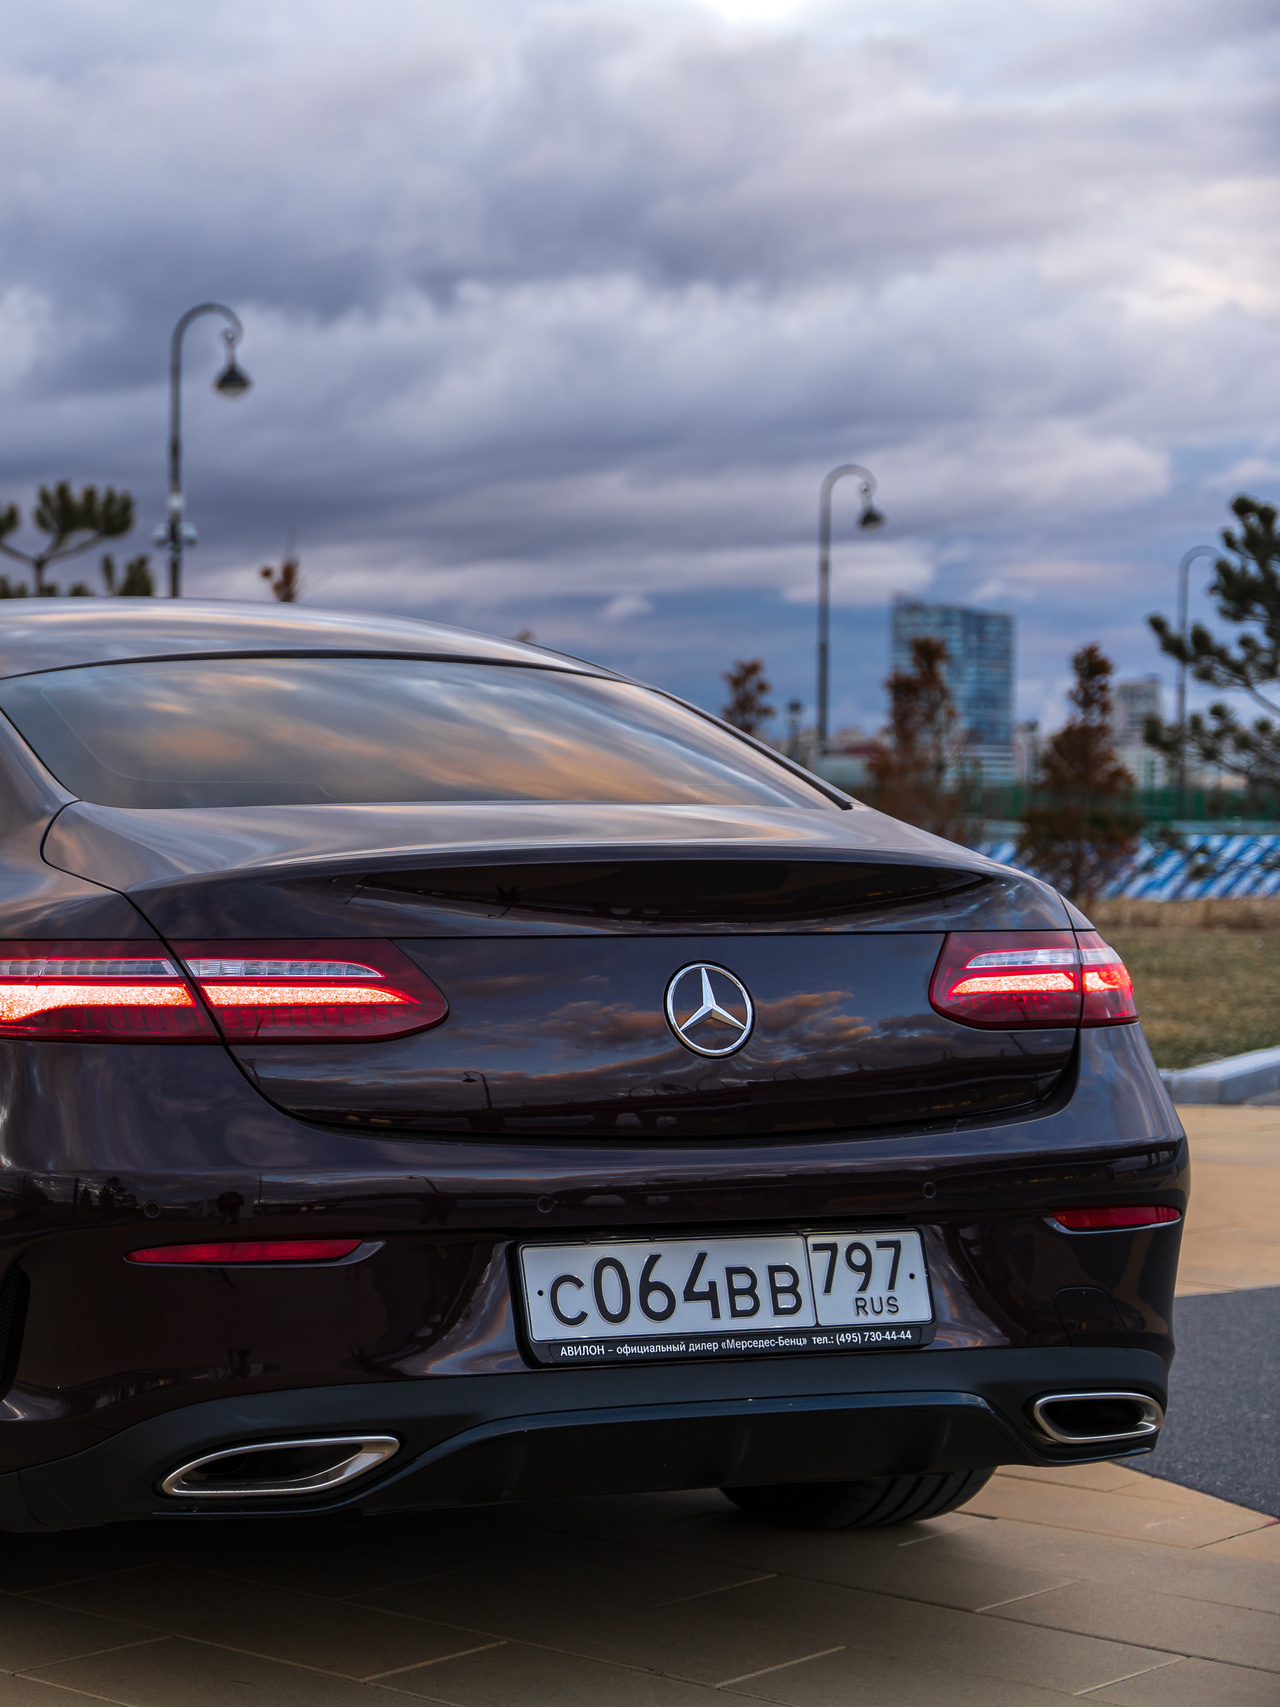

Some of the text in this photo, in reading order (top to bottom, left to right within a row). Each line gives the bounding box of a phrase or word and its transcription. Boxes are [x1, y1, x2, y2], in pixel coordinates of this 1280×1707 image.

[811, 1240, 902, 1294] 797
[854, 1297, 900, 1316] RUS
[560, 1345, 605, 1357] АВИЛОН
[616, 1341, 686, 1356] официальный
[688, 1340, 719, 1352] дилер
[721, 1337, 807, 1350] «Мерседес-Бенц»
[812, 1335, 834, 1345] тел.:
[836, 1332, 862, 1345] (495)
[863, 1330, 912, 1342] 730-44-44
